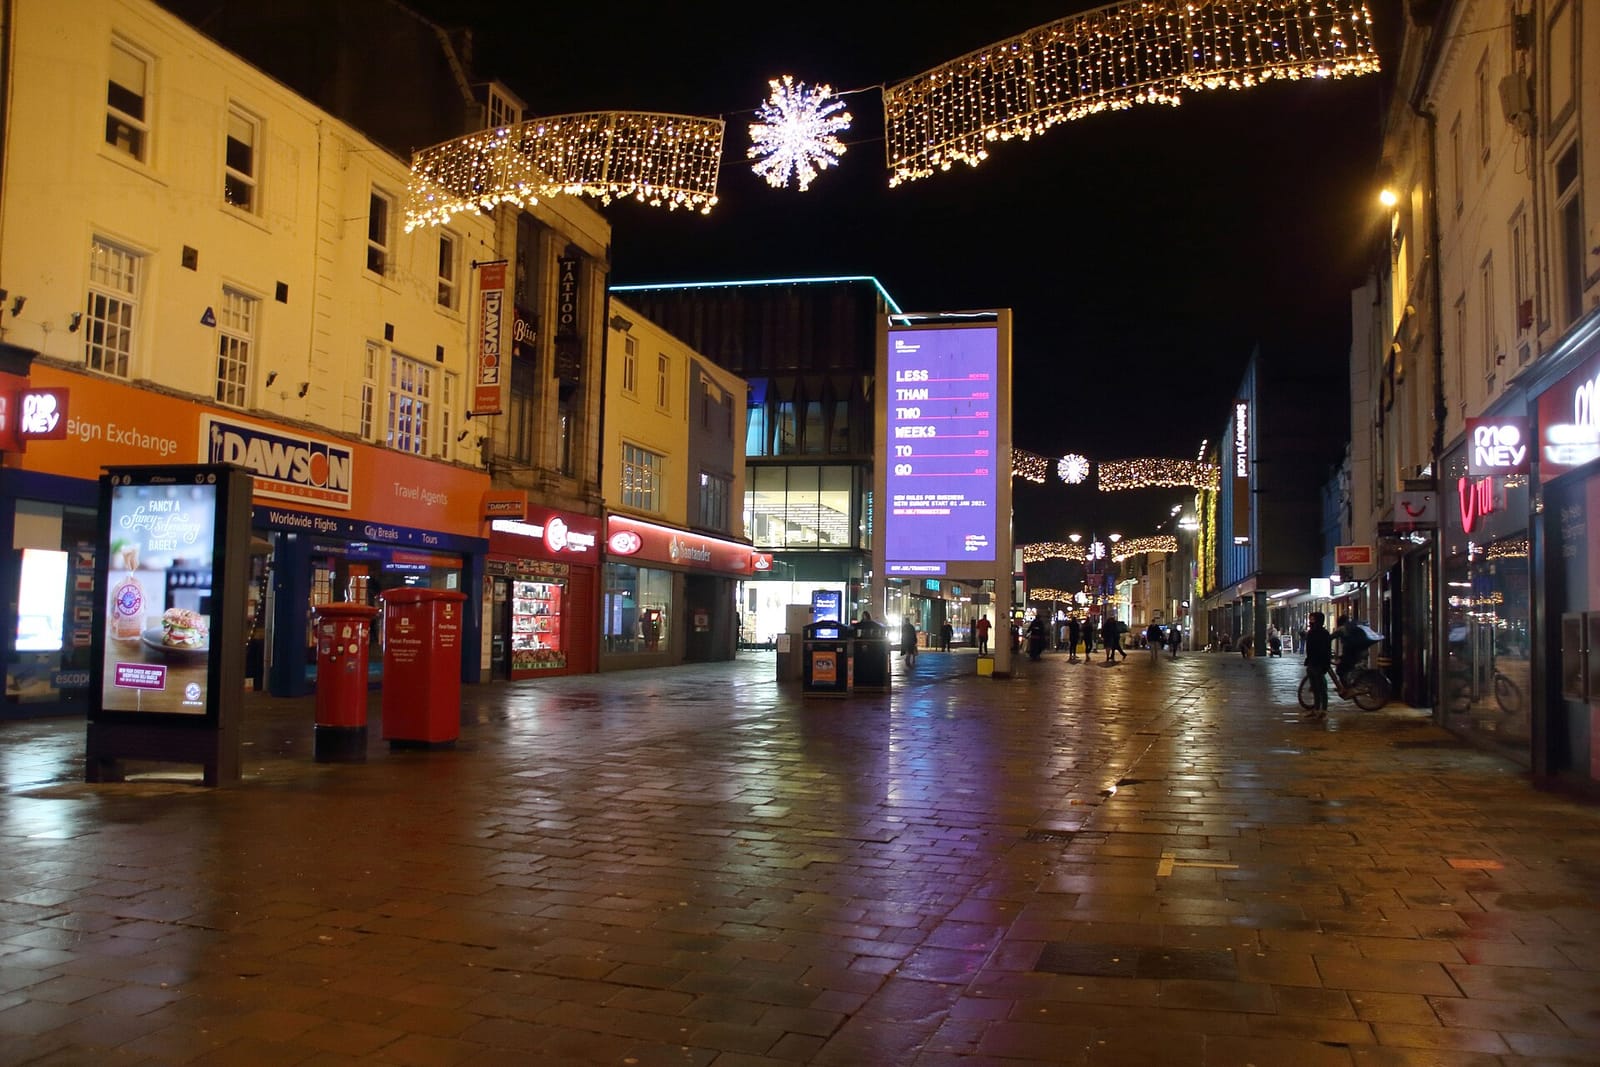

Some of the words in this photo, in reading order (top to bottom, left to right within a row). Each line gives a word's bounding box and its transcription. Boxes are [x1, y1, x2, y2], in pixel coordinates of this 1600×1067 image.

[561, 261, 575, 324] TATTOO
[513, 319, 537, 342] Bliss
[482, 299, 499, 384] DAWSON
[895, 369, 929, 382] LESS
[895, 388, 929, 400] THAN
[895, 407, 921, 419] TWO
[67, 416, 101, 442] eign
[107, 424, 177, 456] Exchange
[895, 426, 936, 438] WEEKS
[223, 432, 349, 490] DAWSON
[895, 445, 912, 457] TO
[1474, 445, 1526, 467] NEY
[895, 464, 912, 476] GO
[1236, 453, 1248, 478] Local
[394, 482, 418, 500] Travel
[420, 484, 447, 506] Agents
[149, 500, 174, 512] FANCY
[174, 500, 181, 512] A
[270, 511, 312, 529] Worldwide
[314, 517, 337, 533] Flights
[364, 525, 378, 538] City
[378, 528, 399, 540] Breaks
[422, 533, 438, 545] Tours
[149, 539, 177, 552] BAGEL?
[679, 541, 711, 562] Santander
